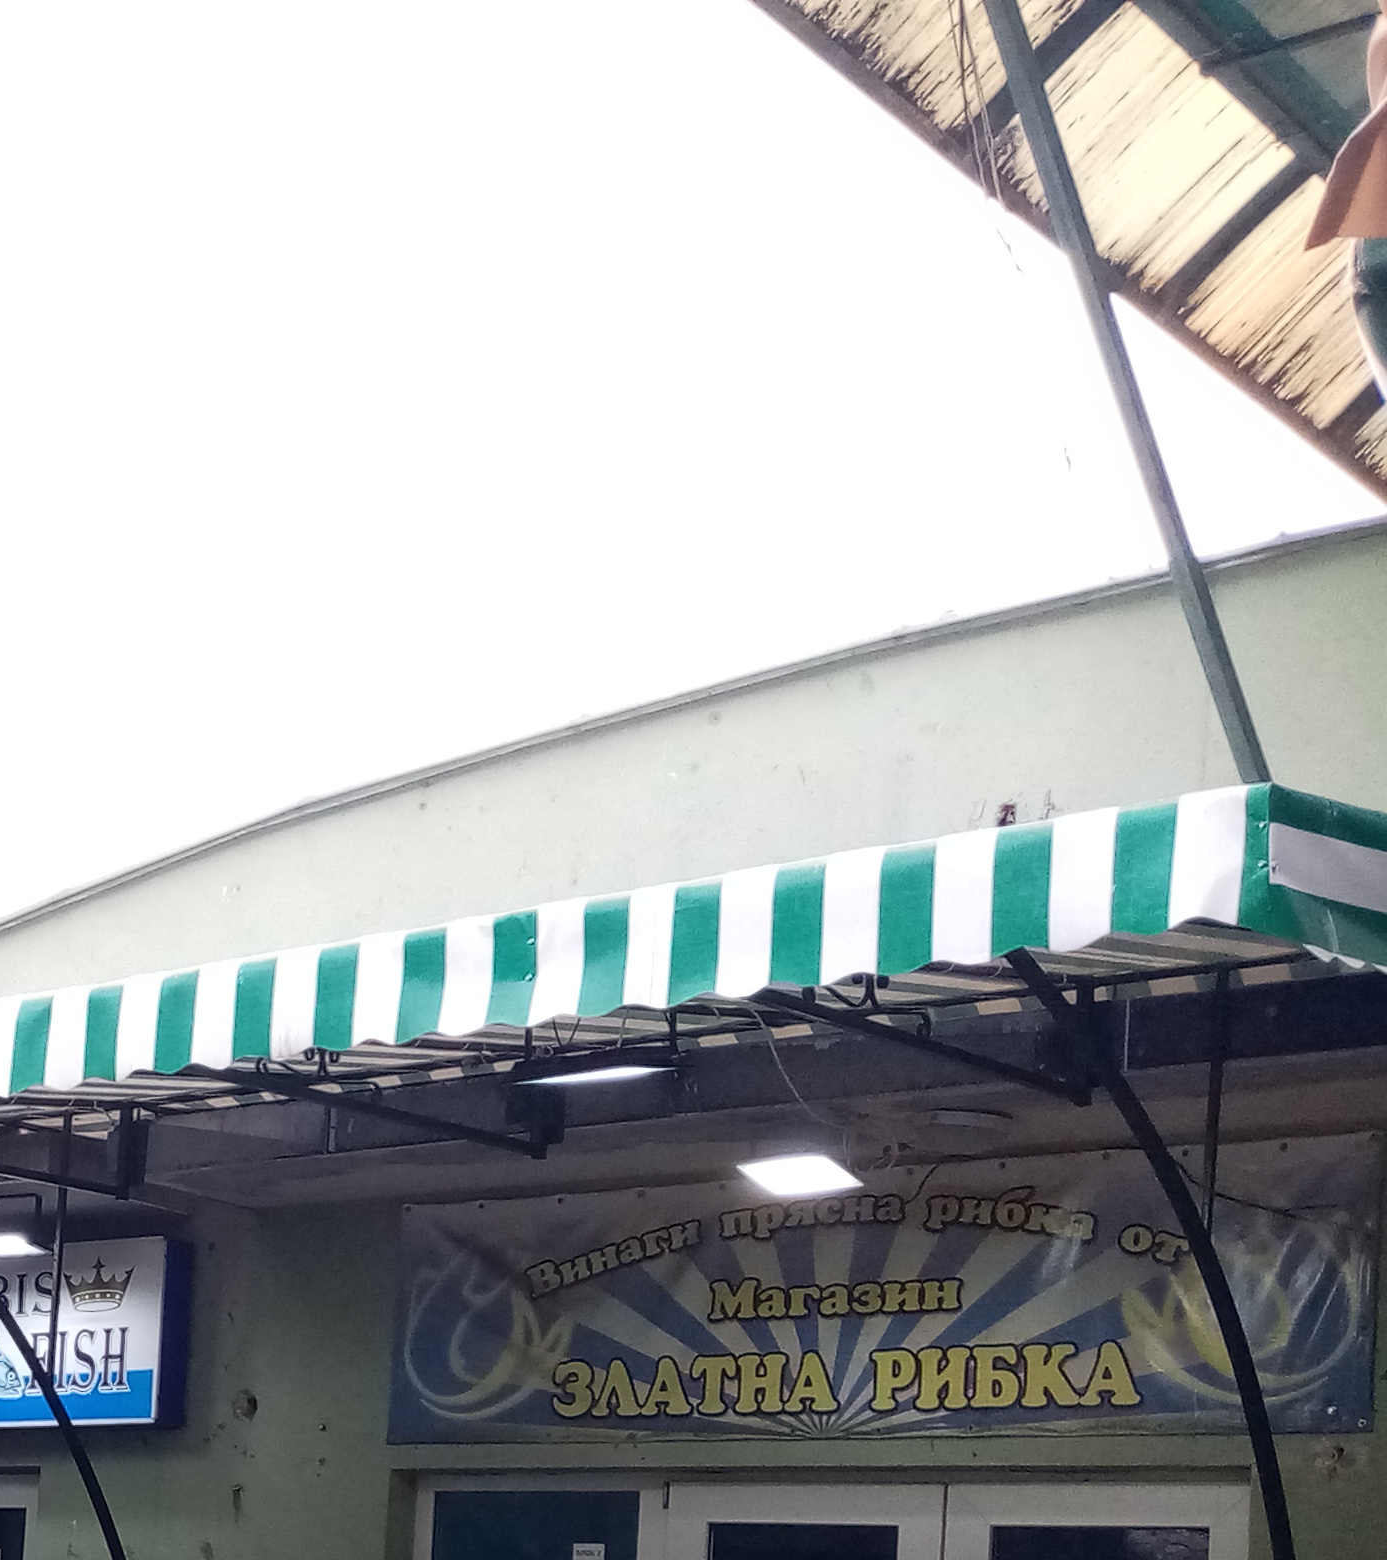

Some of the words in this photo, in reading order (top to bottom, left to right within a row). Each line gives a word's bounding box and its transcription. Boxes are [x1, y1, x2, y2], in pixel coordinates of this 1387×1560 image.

[524, 1216, 701, 1299] Винаги
[717, 1192, 906, 1240] прясна
[926, 1186, 1096, 1241] рибка
[1119, 1221, 1191, 1271] от
[708, 1273, 964, 1323] Магазин
[551, 1348, 838, 1420] ЗЛАТНА
[870, 1340, 1142, 1415] РИБКА
